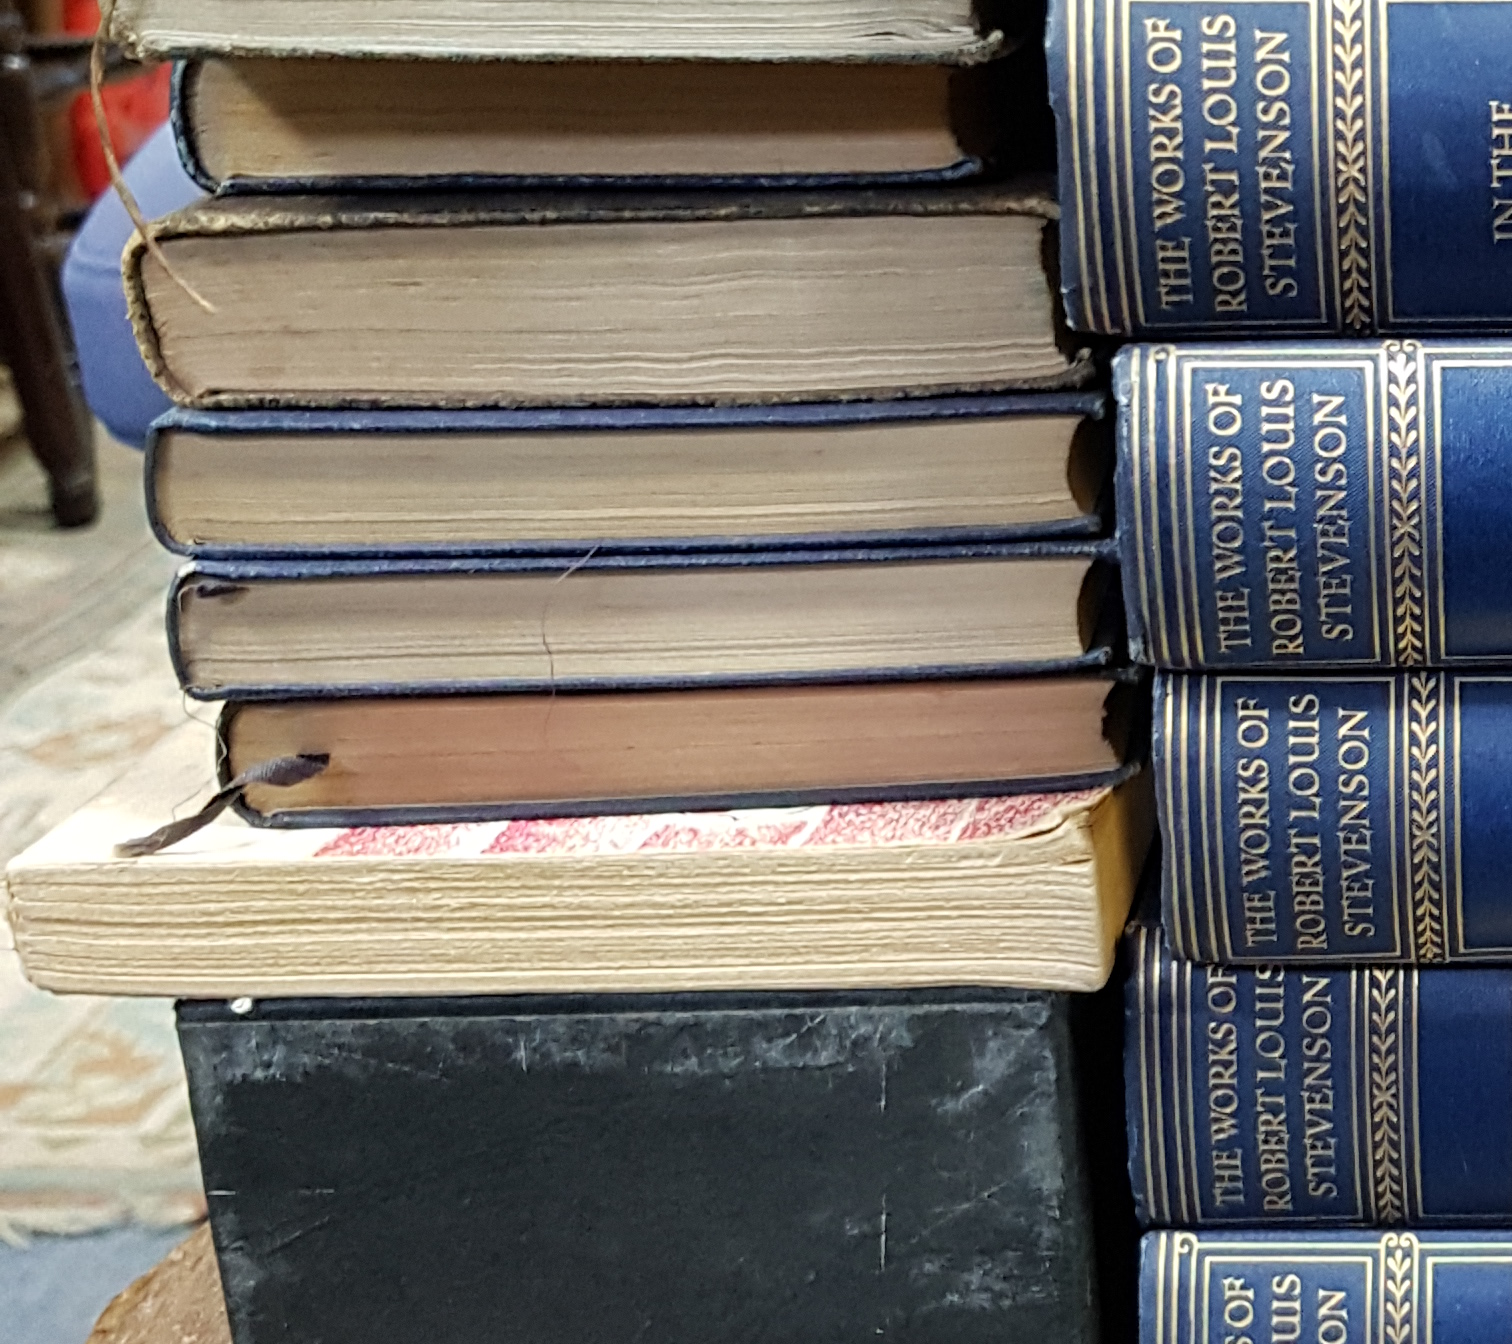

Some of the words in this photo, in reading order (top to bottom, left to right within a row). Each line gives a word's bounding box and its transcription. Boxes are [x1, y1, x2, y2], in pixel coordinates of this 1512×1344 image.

[1144, 17, 1182, 73] OF
[1202, 14, 1240, 154] LOUIS
[1148, 83, 1185, 229] WORKS
[1254, 28, 1299, 297] STEVENSON
[1155, 238, 1194, 307] THE
[1203, 163, 1248, 312] ROBERT
[1205, 383, 1242, 436] OF
[1260, 379, 1298, 511] LOUIS
[1209, 447, 1245, 582] WORKS
[1313, 393, 1354, 640] STEVENSON
[1216, 587, 1252, 653] THE
[1263, 521, 1305, 655] ROBERT
[1236, 697, 1269, 748] OF
[1288, 694, 1321, 820] LOUIS
[1237, 758, 1271, 885] WORKS
[1336, 708, 1375, 937] STEVENSON
[1243, 891, 1277, 946] THE
[1287, 829, 1328, 950] ROBERT
[1206, 966, 1237, 1014] OF
[1254, 964, 1287, 1081] LOUIS
[1208, 1022, 1239, 1143] WORKS
[1300, 975, 1338, 1197] STEVENSON
[1212, 1149, 1245, 1206] THE
[1255, 1088, 1293, 1211] ROBERT
[1222, 1277, 1255, 1327] OF
